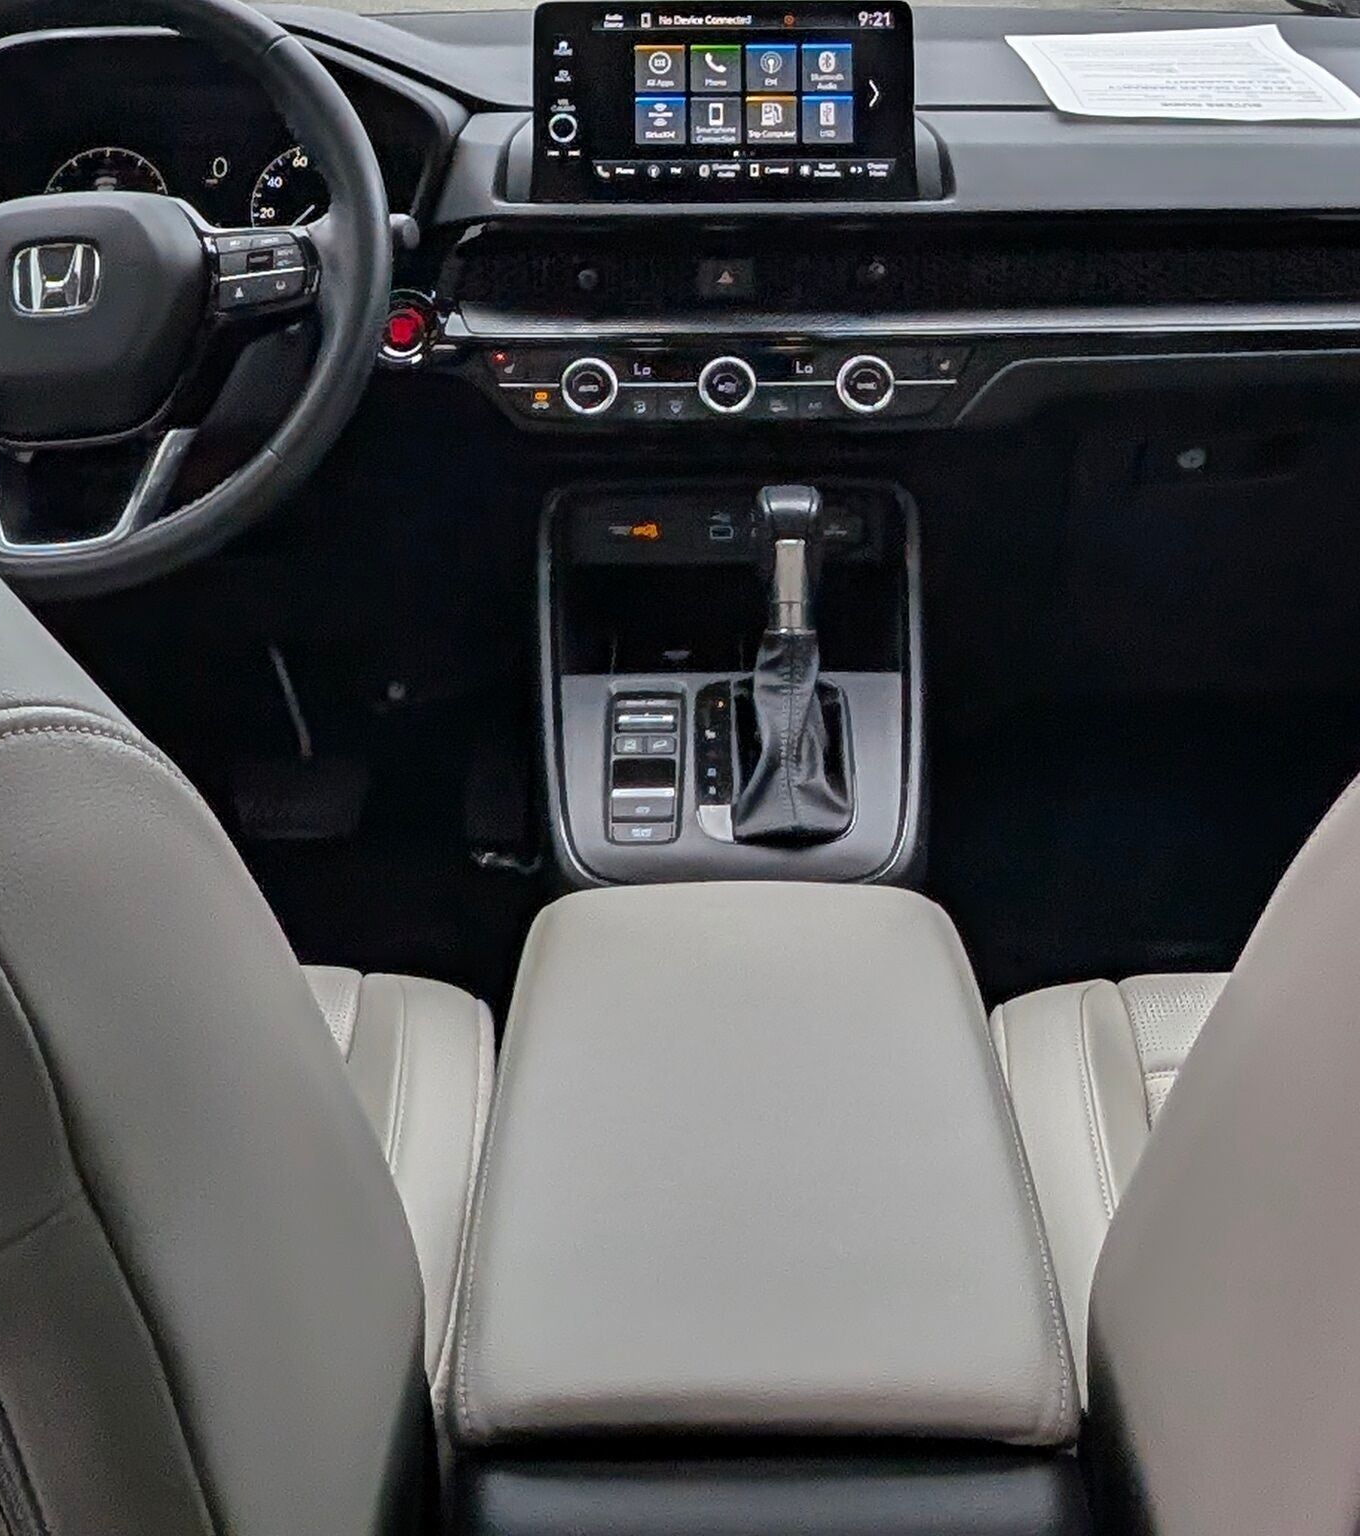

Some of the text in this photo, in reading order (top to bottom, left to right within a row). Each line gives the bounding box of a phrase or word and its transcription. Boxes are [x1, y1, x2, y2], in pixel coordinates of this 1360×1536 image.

[658, 14, 752, 25] No Device Connected
[858, 11, 891, 27] 9:21
[292, 156, 309, 167] 60
[213, 157, 228, 178] 0
[267, 177, 283, 188] 40
[260, 207, 276, 218] 20
[633, 363, 651, 375] Lo
[796, 361, 813, 374] Lo
